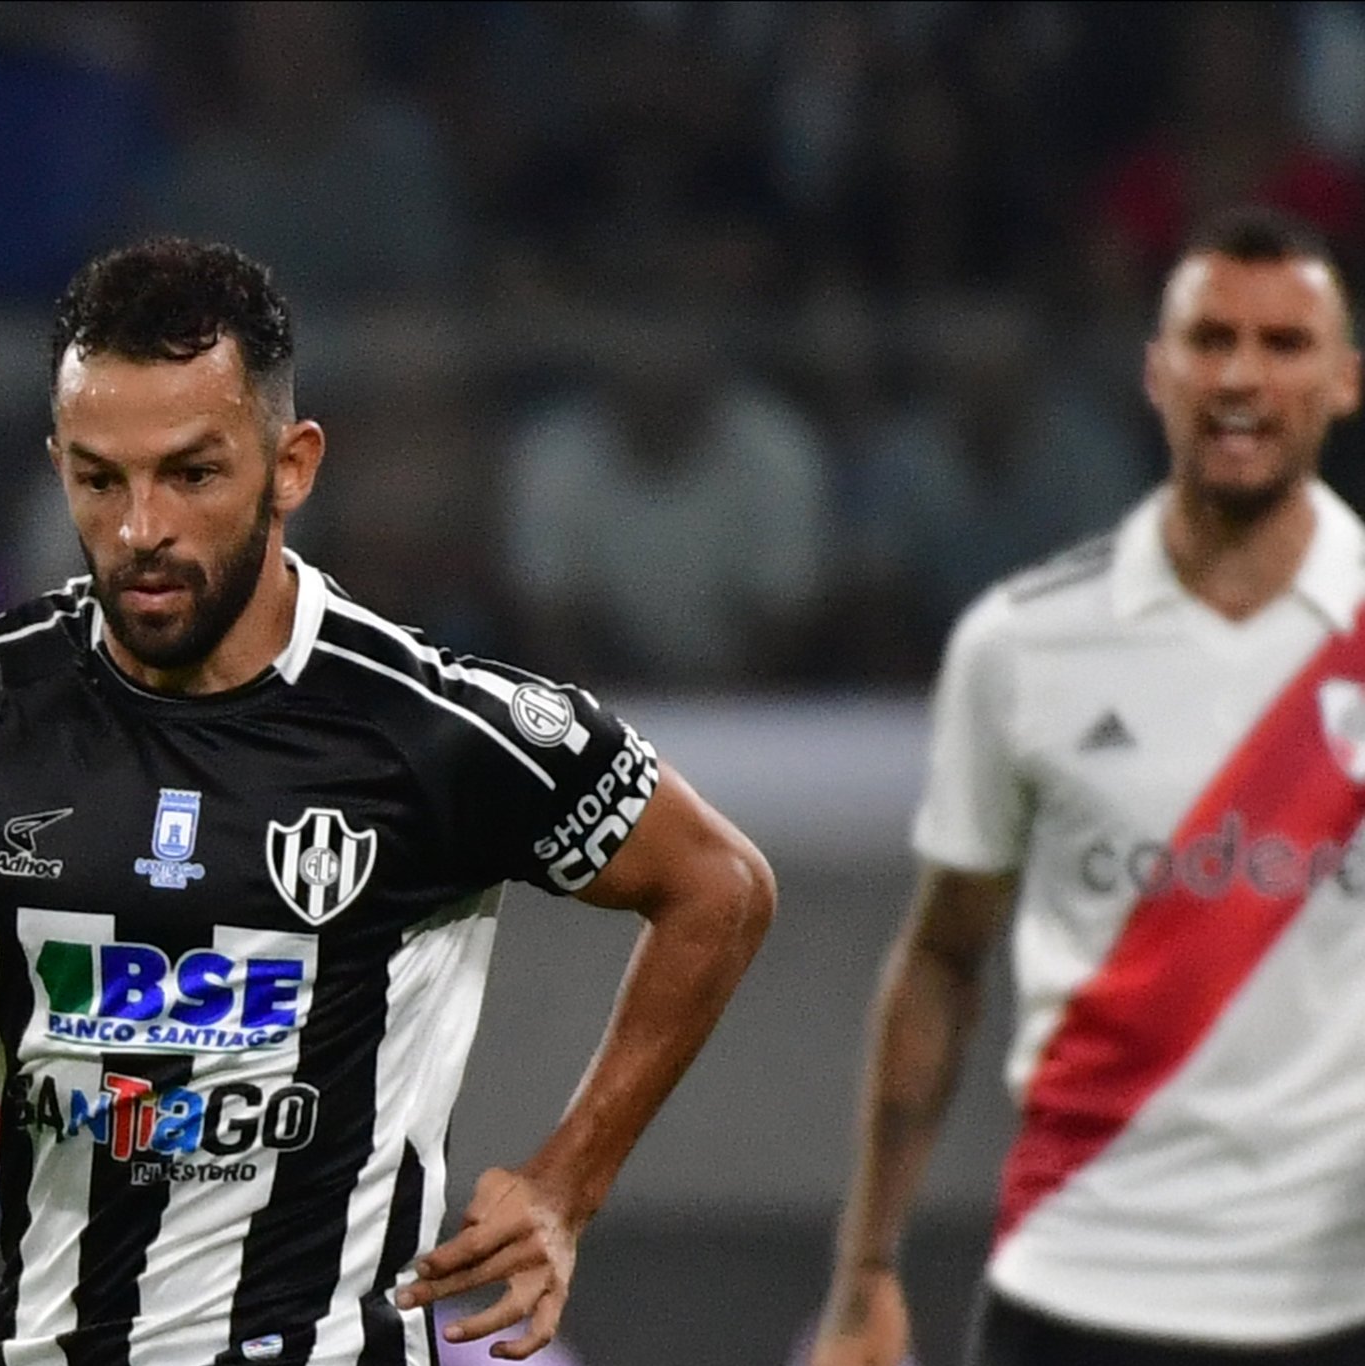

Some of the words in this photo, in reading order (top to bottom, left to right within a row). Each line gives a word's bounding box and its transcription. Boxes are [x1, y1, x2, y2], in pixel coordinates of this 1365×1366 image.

[98, 944, 305, 1028] BSE
[48, 1013, 136, 1042] BANCO
[145, 1023, 291, 1047] SANTIAGO
